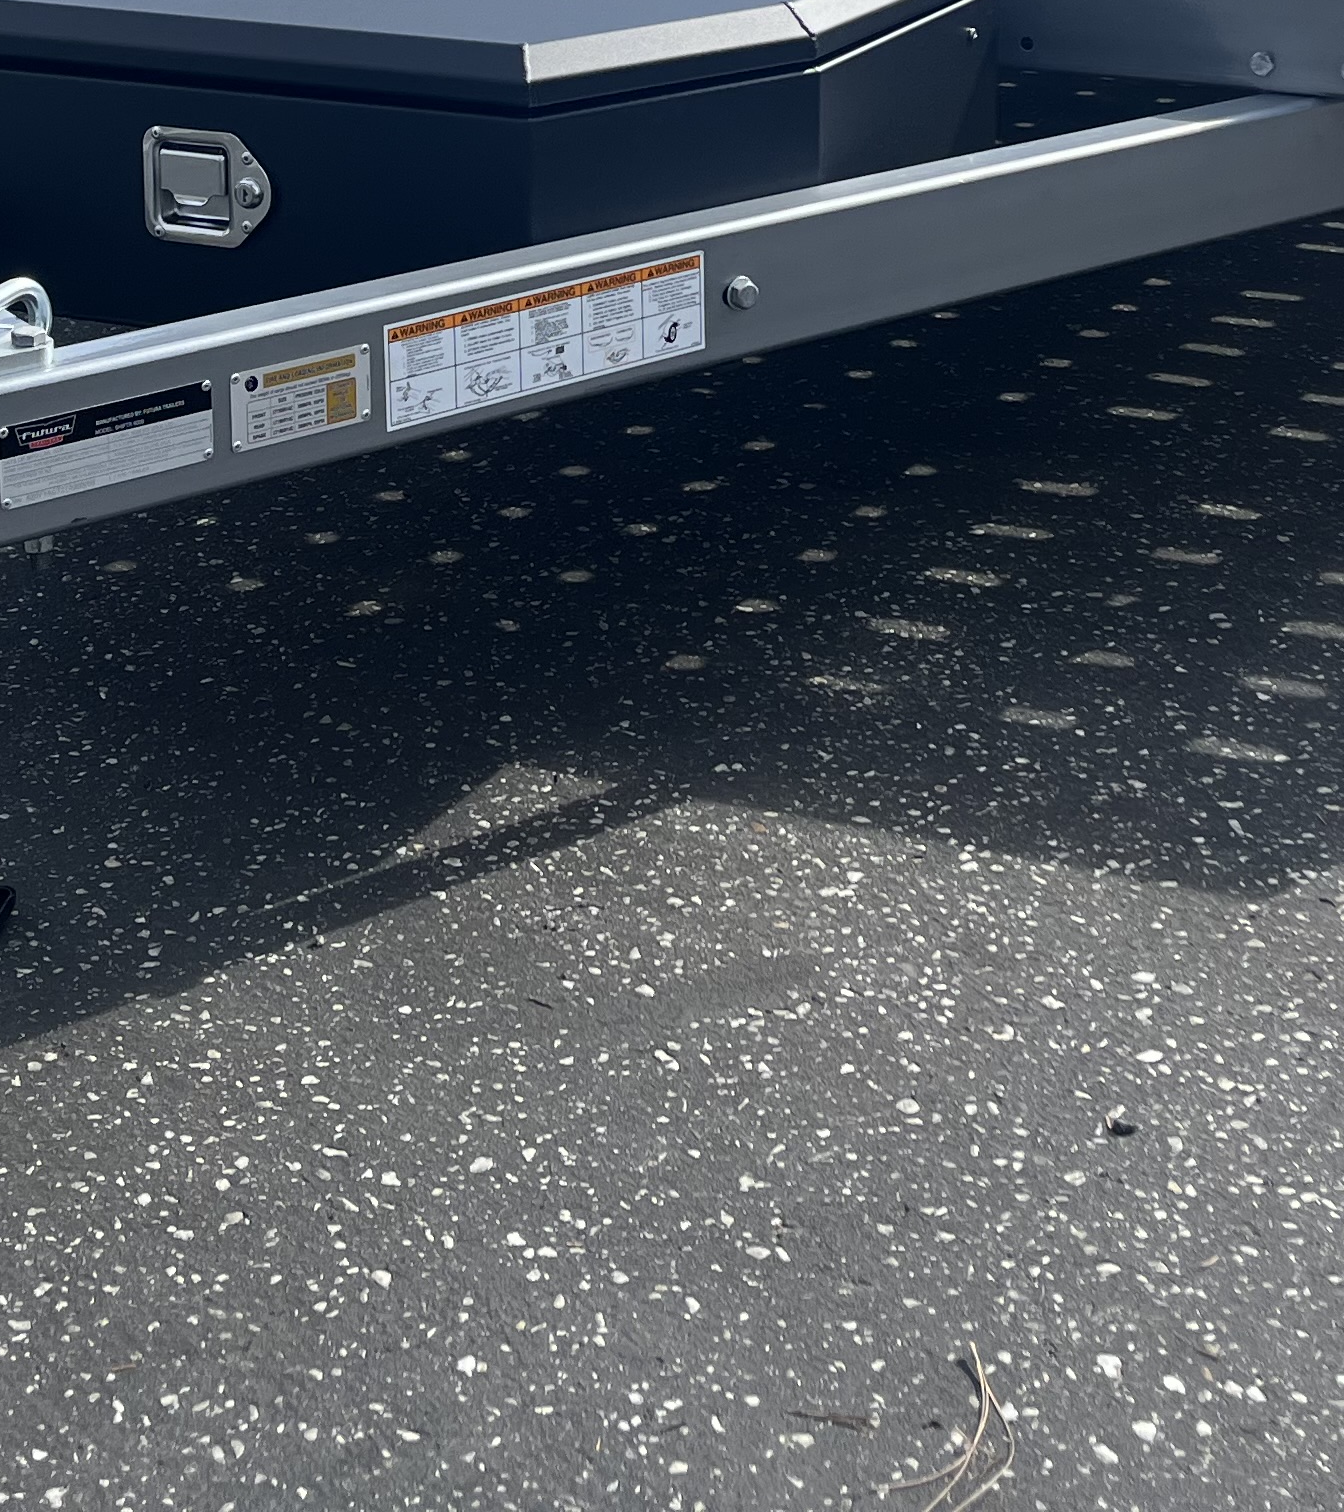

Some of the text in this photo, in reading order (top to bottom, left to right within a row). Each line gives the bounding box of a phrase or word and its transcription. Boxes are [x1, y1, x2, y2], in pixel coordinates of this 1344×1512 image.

[654, 258, 695, 278] WARNING
[593, 272, 637, 291] WARNING
[532, 287, 576, 305] WARNING
[467, 302, 513, 322] WARNING
[399, 318, 446, 338] WARNING
